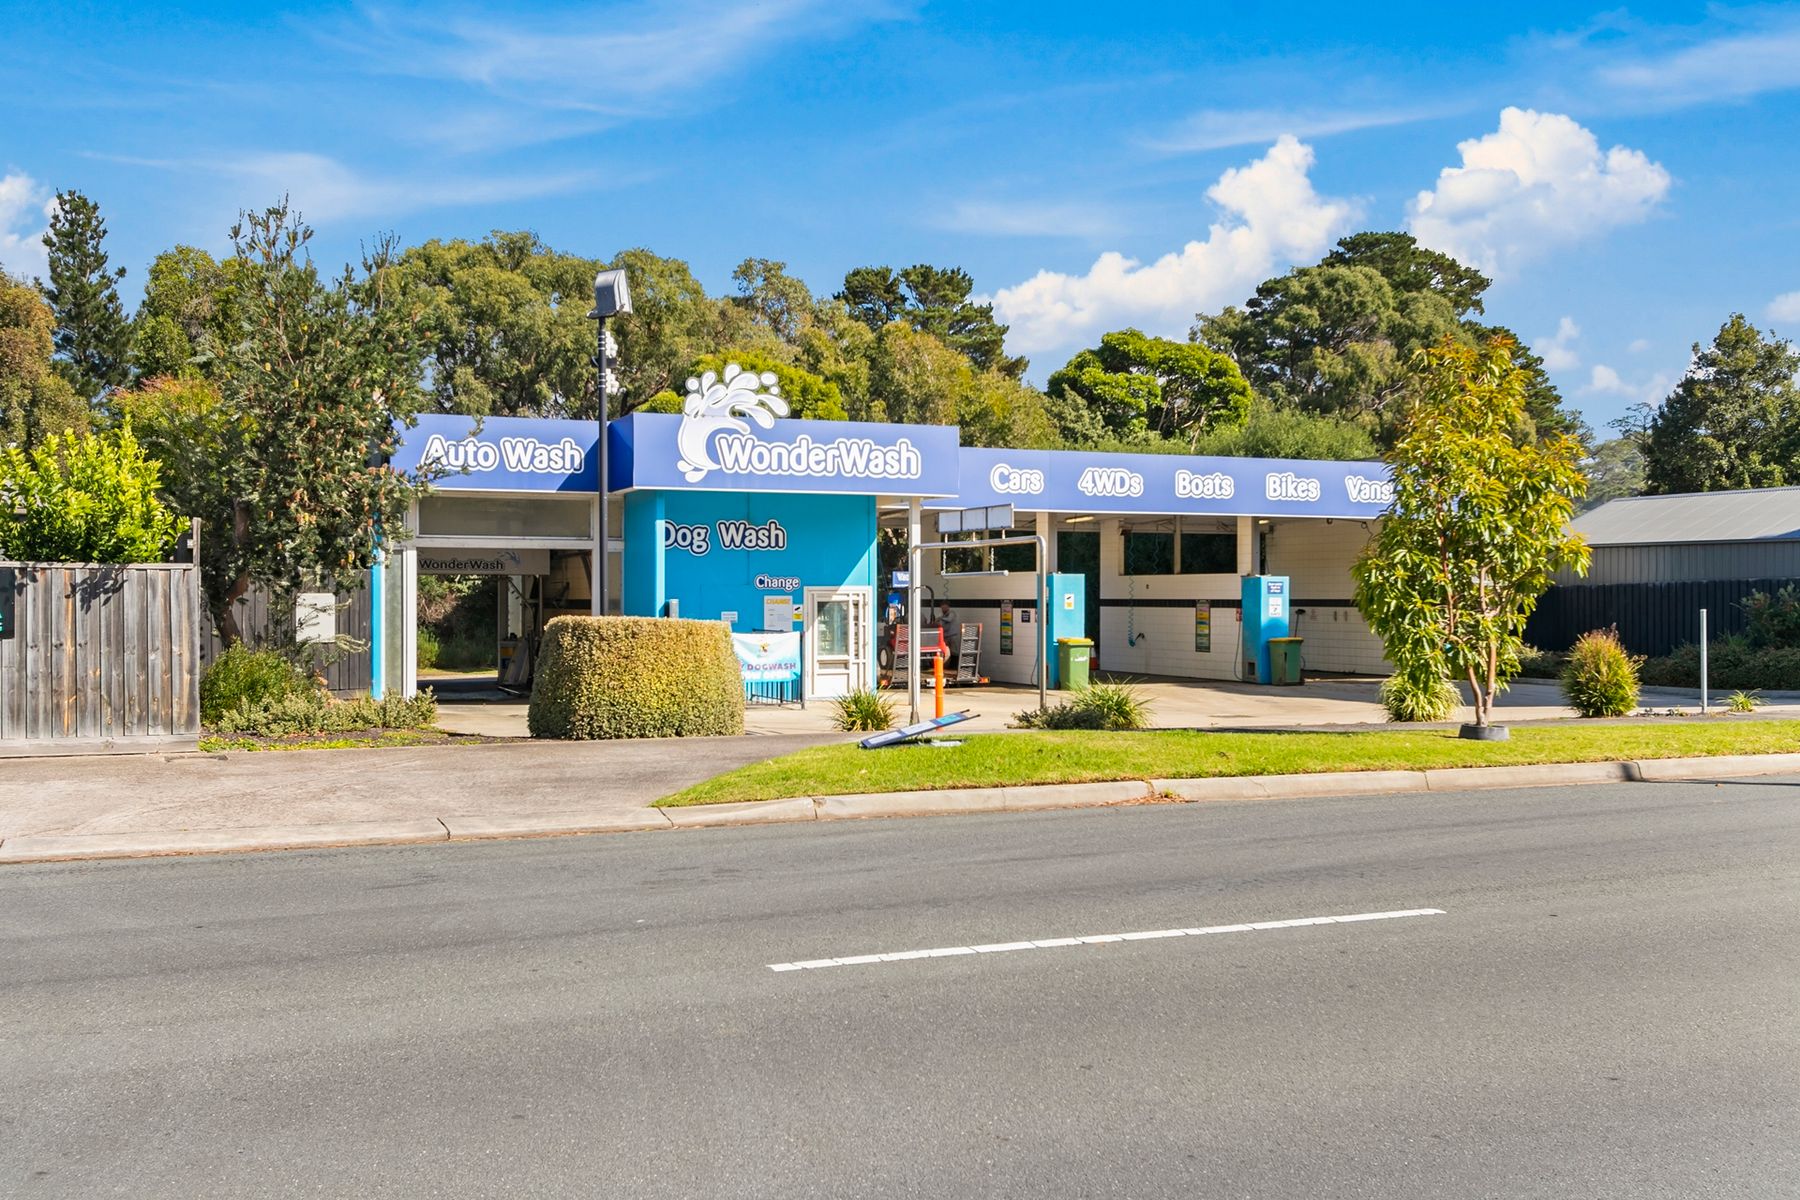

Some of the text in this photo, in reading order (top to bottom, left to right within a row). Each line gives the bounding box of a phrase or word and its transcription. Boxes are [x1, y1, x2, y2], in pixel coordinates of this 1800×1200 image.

[421, 436, 583, 473] Auto Wash
[716, 435, 920, 478] WonderWash
[991, 464, 1043, 494] Cars
[1079, 467, 1143, 497] 4WDs
[1176, 470, 1234, 499] Boats
[1266, 473, 1320, 500] Bikes
[1345, 476, 1393, 503] Vans
[717, 520, 785, 550] Wash
[419, 558, 504, 570] WonderWash
[755, 574, 799, 591] Change
[746, 663, 796, 671] DOGWASH
